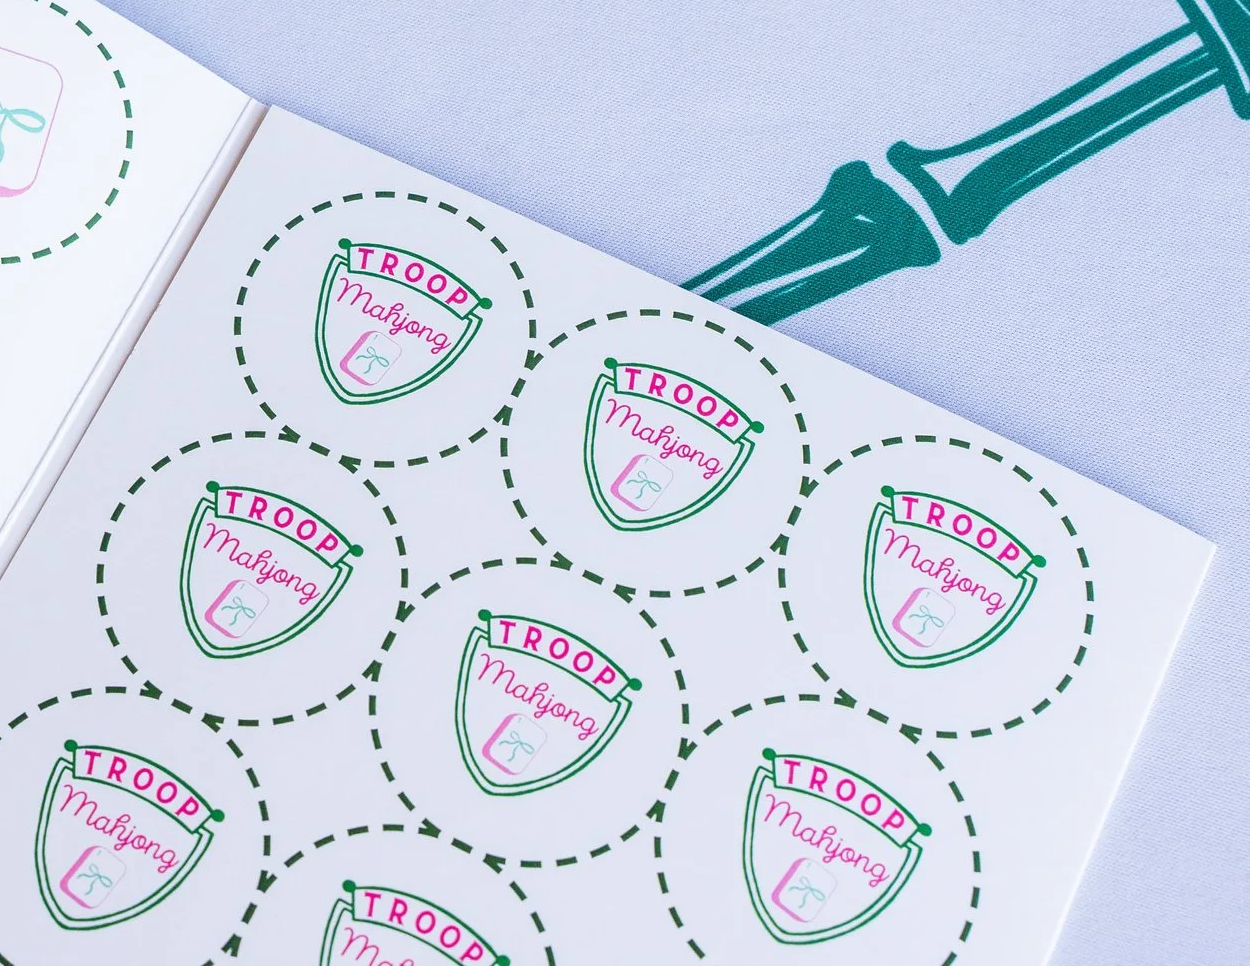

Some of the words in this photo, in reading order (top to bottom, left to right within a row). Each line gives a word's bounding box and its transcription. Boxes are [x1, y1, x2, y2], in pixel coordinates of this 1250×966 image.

[357, 247, 468, 305] TROOP
[336, 277, 451, 355] Mahjong
[624, 367, 739, 429] TROOP
[605, 398, 724, 480] Mahjong
[226, 490, 339, 552] TROOP
[901, 495, 1020, 561] TROOP
[202, 522, 320, 605] Mahjong
[883, 527, 1006, 615] Mahjong
[499, 620, 616, 685] TROOP
[478, 653, 599, 740] Mahjong
[84, 750, 199, 816] TROOP
[784, 759, 905, 829] TROOP
[60, 784, 179, 874] Mahjong
[764, 793, 890, 887] Mahjong
[364, 891, 483, 961] TROOP
